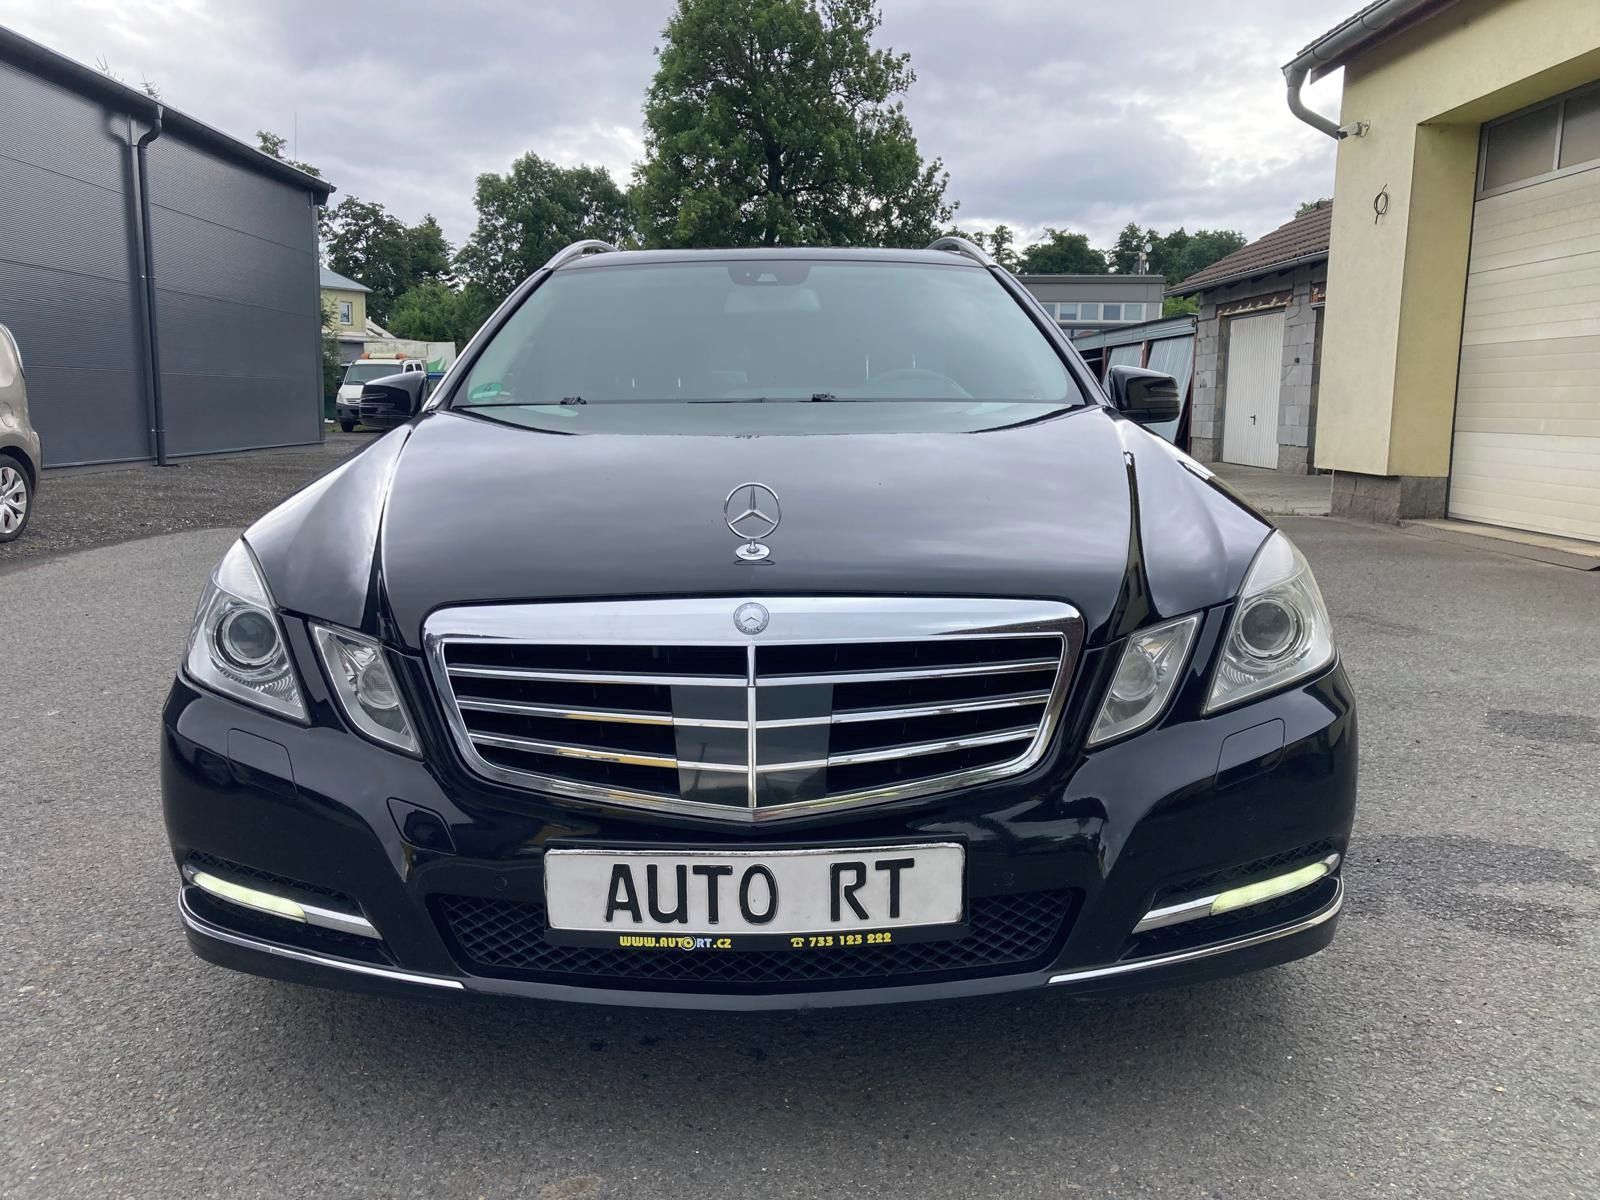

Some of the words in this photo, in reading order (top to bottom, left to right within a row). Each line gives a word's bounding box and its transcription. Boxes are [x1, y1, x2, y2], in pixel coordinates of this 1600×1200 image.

[605, 863, 779, 925] AUTO
[829, 858, 915, 922] RT
[808, 936, 834, 948] 733
[839, 934, 863, 946] 123
[866, 932, 892, 944] 222
